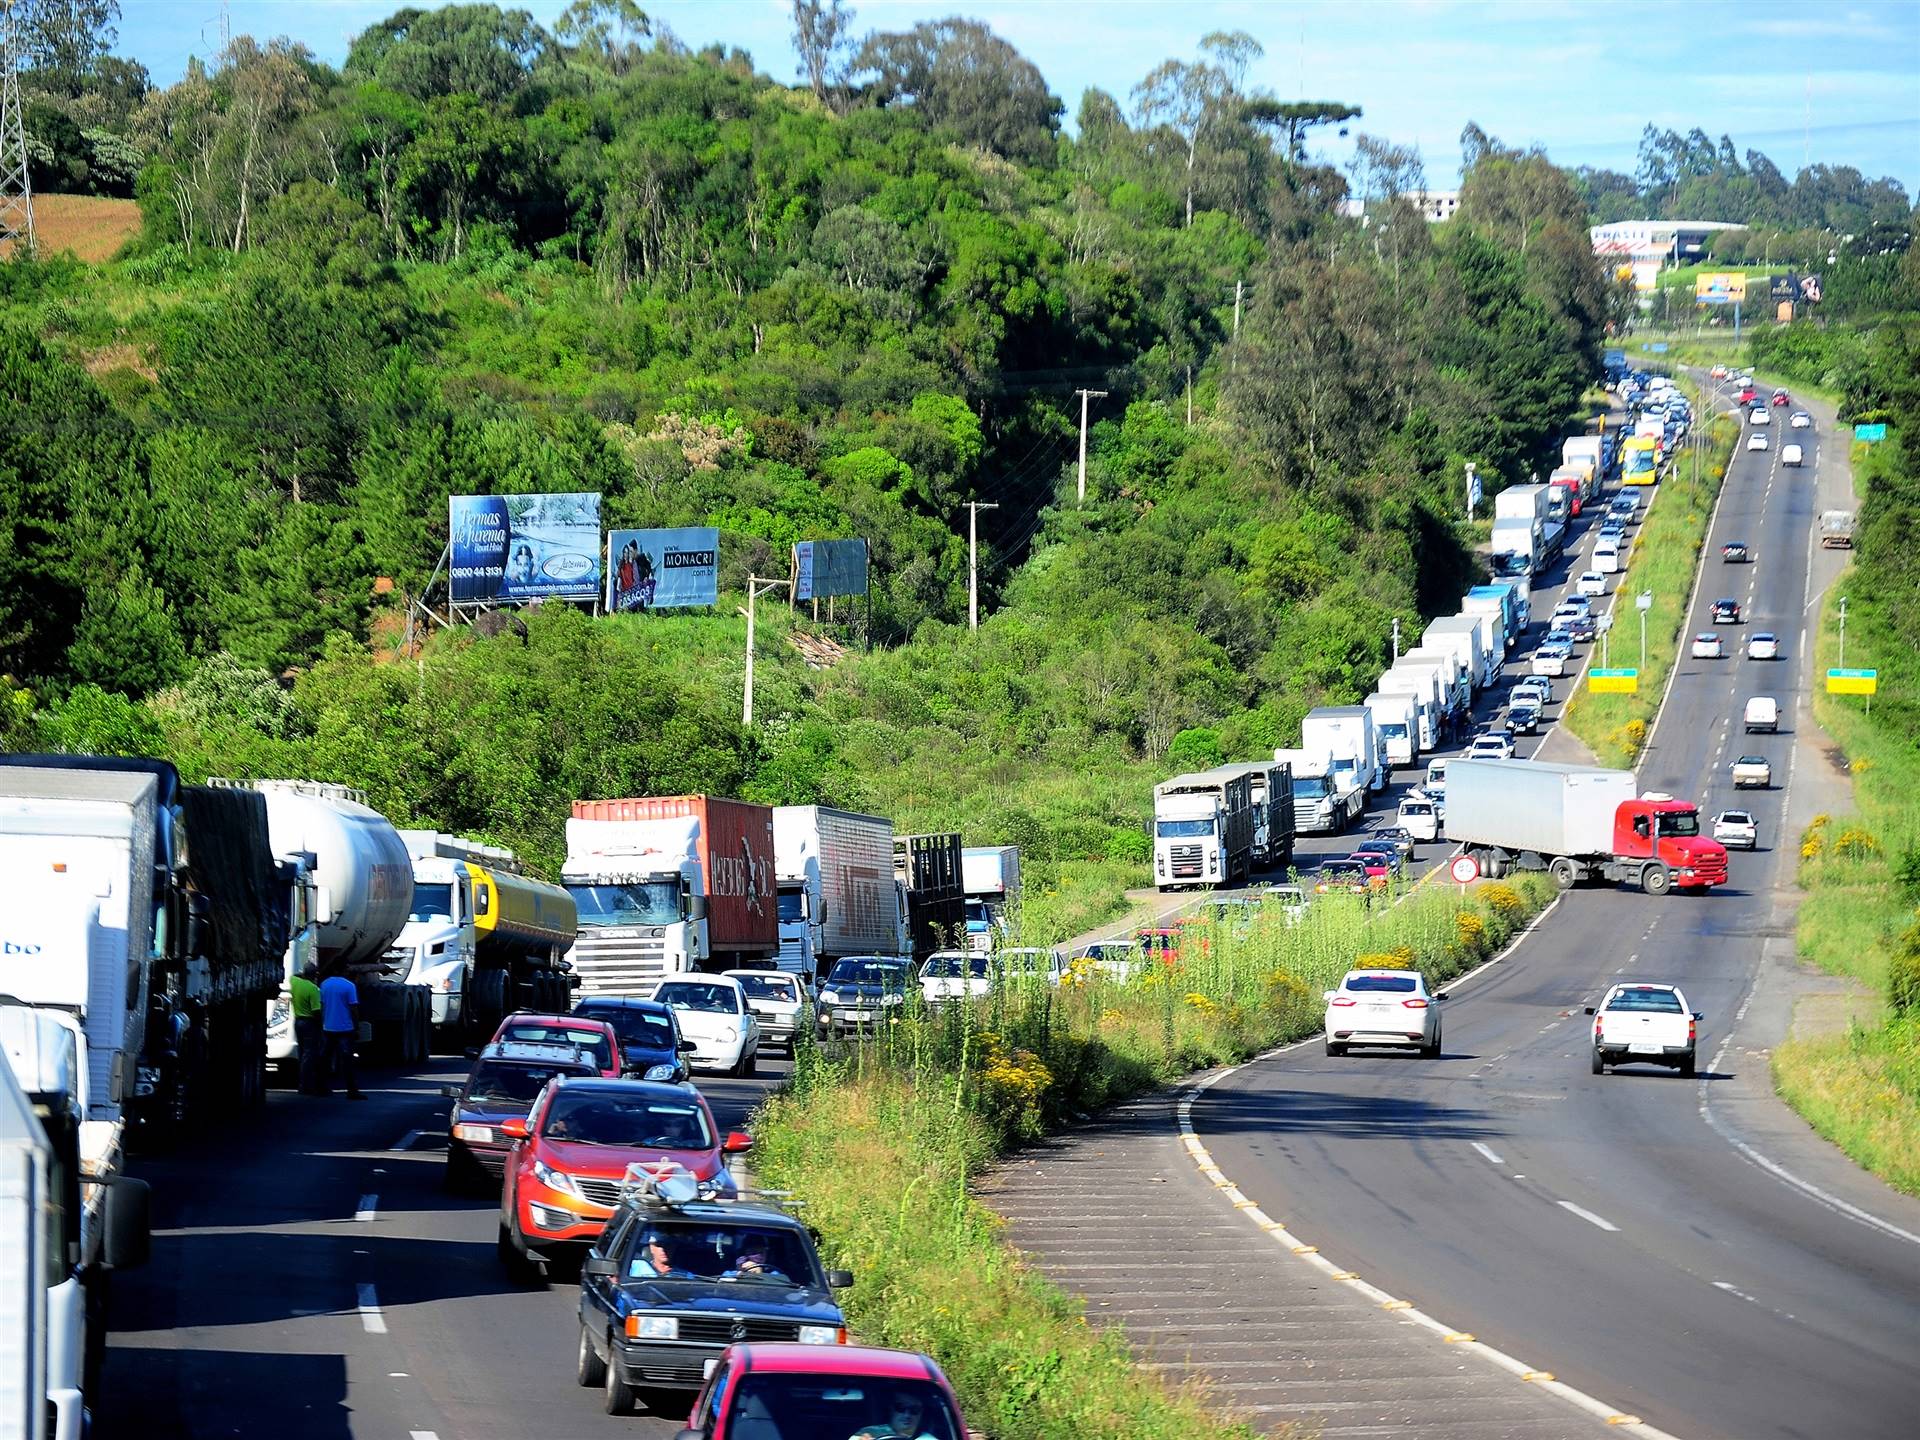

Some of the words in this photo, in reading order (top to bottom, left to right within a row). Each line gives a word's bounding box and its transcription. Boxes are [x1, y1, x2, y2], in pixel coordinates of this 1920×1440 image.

[461, 508, 501, 526] Termas
[452, 530, 465, 543] de
[464, 524, 506, 548] Jurema
[666, 553, 713, 566] MONACRI
[452, 568, 472, 578] 0800
[473, 567, 485, 577] 44
[486, 566, 503, 577] 3131
